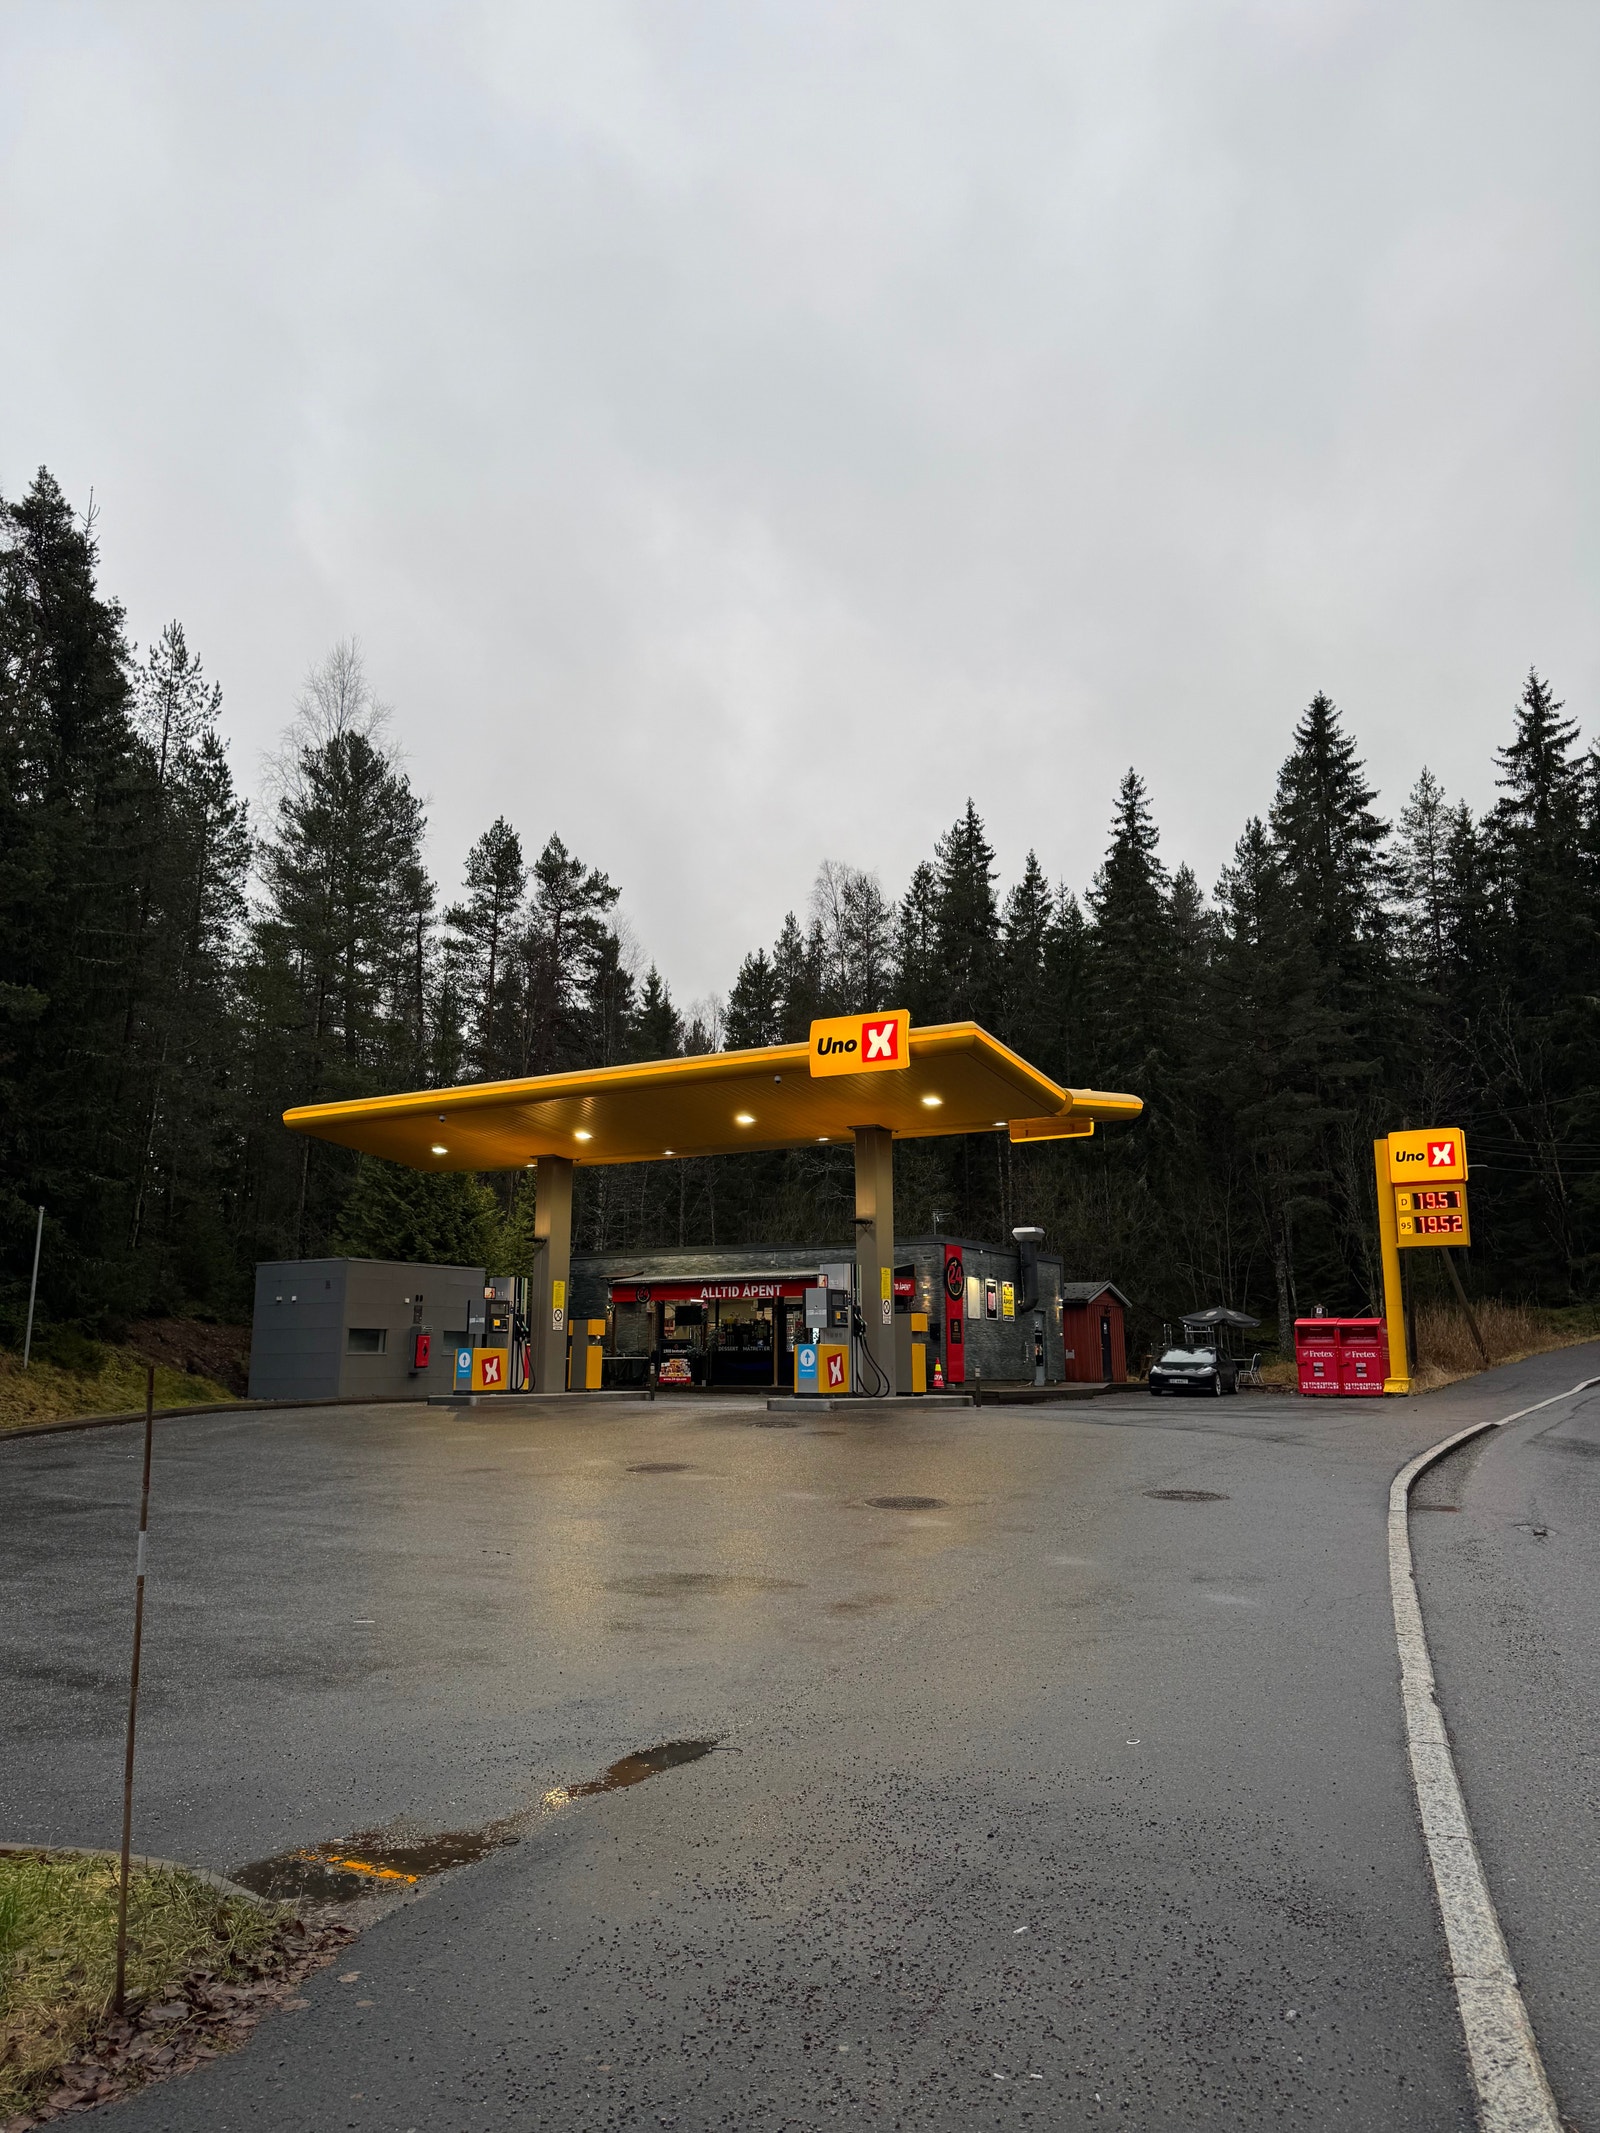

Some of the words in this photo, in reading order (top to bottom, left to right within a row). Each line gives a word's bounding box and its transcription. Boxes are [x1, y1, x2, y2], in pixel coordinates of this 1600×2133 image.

[817, 1037, 857, 1055] Uno
[866, 1023, 894, 1058] X
[1395, 1151, 1425, 1162] Uno
[1432, 1143, 1452, 1165] X
[1401, 1198, 1408, 1206] D
[1418, 1191, 1461, 1210] 19.51
[1420, 1215, 1463, 1234] 19.52
[949, 1265, 962, 1284] 24
[700, 1286, 740, 1298] ALLTID
[742, 1283, 782, 1297] ÅPENT
[485, 1358, 498, 1383] X
[830, 1355, 842, 1385] X
